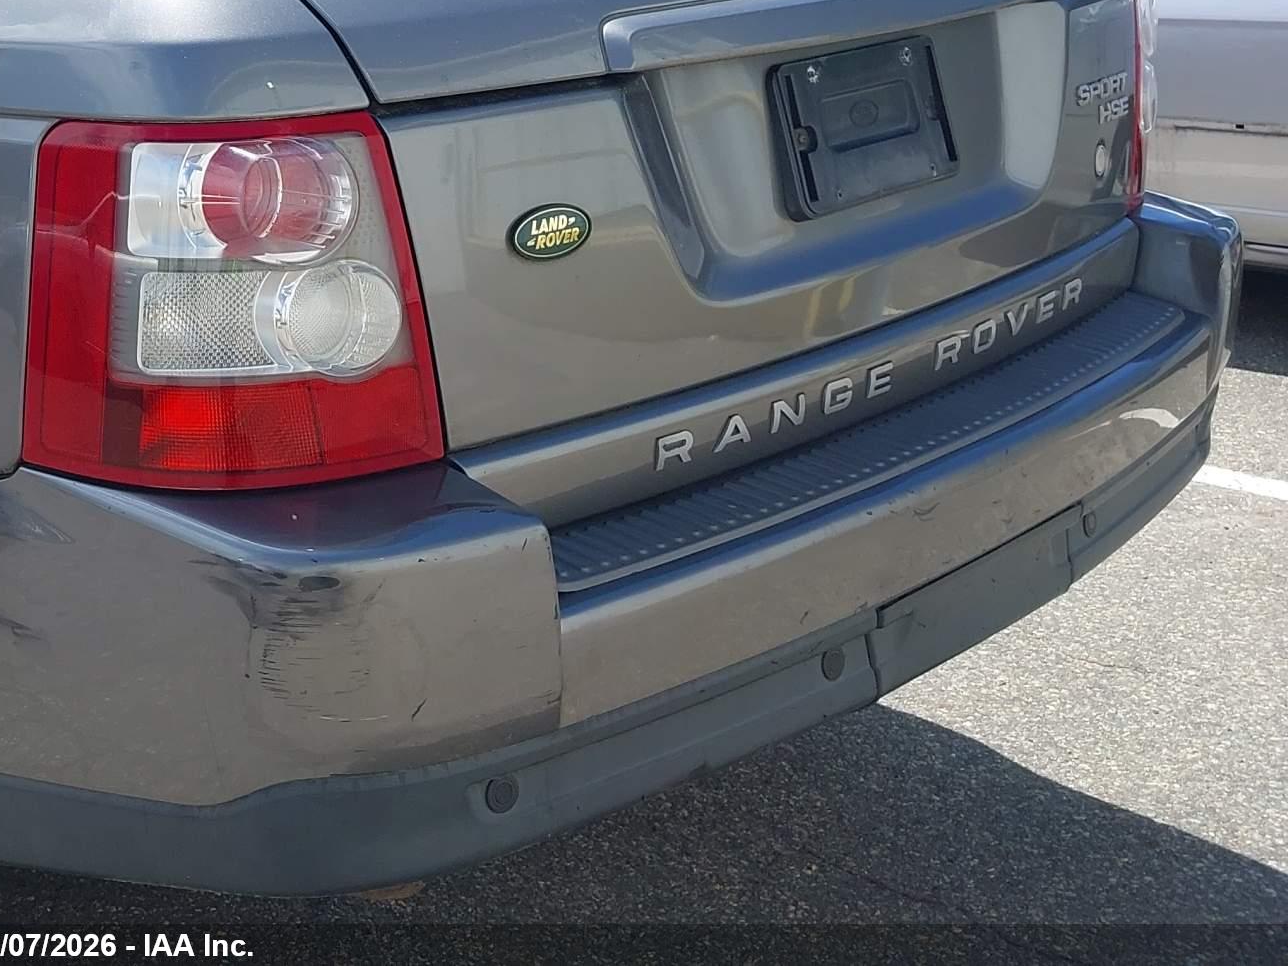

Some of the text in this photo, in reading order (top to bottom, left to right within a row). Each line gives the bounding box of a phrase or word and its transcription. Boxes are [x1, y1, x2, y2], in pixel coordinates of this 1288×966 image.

[1076, 71, 1128, 106] SPORT
[1098, 96, 1129, 125] HSE
[531, 214, 568, 236] LAND
[535, 227, 580, 250] ROVER
[655, 277, 1083, 472] RANGE ROVER
